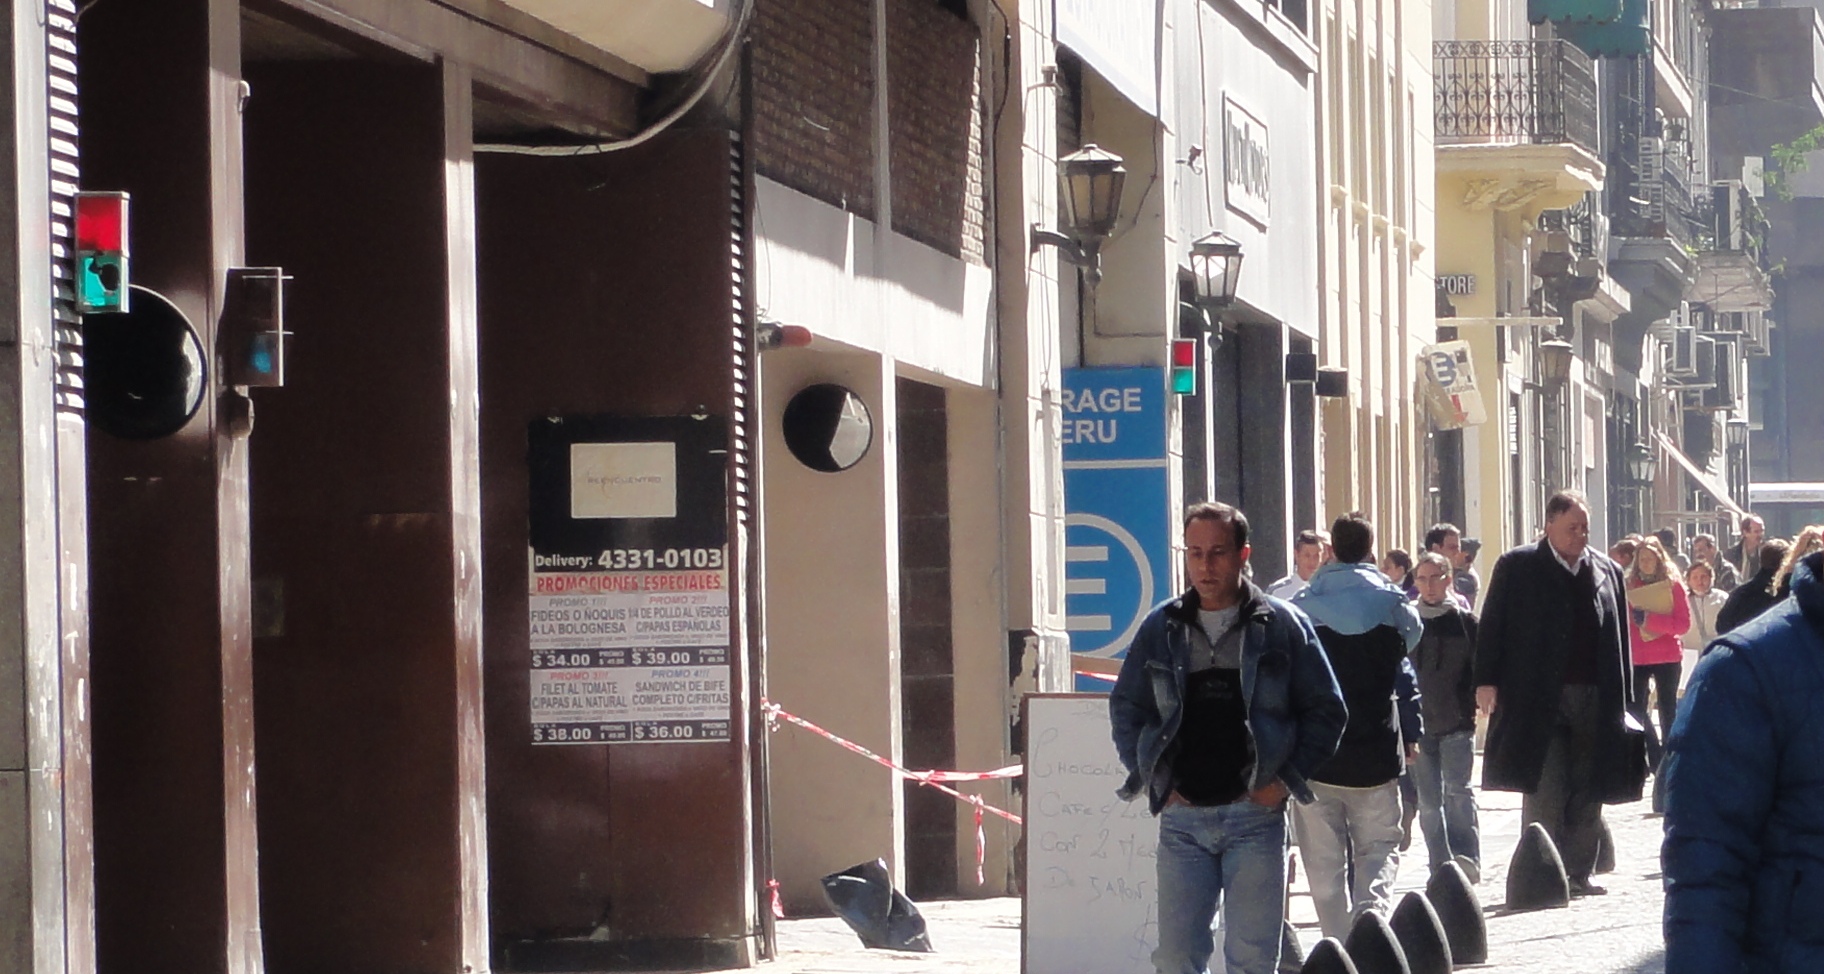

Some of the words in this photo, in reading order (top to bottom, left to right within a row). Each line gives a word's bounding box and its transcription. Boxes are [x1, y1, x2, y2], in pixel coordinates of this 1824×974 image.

[535, 553, 593, 569] Delivery:
[597, 548, 722, 569] 4331-0103
[537, 576, 638, 592] PROMOCIONES
[643, 574, 721, 591] ESPECIALES
[649, 595, 688, 605] PROMO
[531, 609, 570, 622] FIDEOS
[572, 609, 581, 621] O
[640, 607, 652, 619] DE
[653, 607, 683, 619] POLLO
[531, 623, 539, 635] A
[541, 623, 556, 635] LA
[558, 621, 627, 635] BOLOGNESA
[532, 653, 542, 667] $
[547, 653, 590, 667] 34.00
[632, 651, 642, 665] $
[646, 651, 691, 665] 39.00
[550, 671, 589, 681] PROMO
[651, 669, 691, 679] PROMO
[541, 682, 565, 695] FILET
[567, 682, 579, 694] AL
[582, 681, 618, 694] TOMATE
[635, 680, 686, 692] SANDWICH
[688, 680, 702, 691] DE
[703, 680, 725, 691] BIFE
[572, 696, 583, 708] AL
[585, 695, 628, 708] NATURAL
[632, 693, 684, 706] COMPLETO
[533, 727, 543, 741] $
[547, 727, 592, 741] 38.00
[634, 725, 645, 739] $
[648, 725, 693, 739] 36.00
